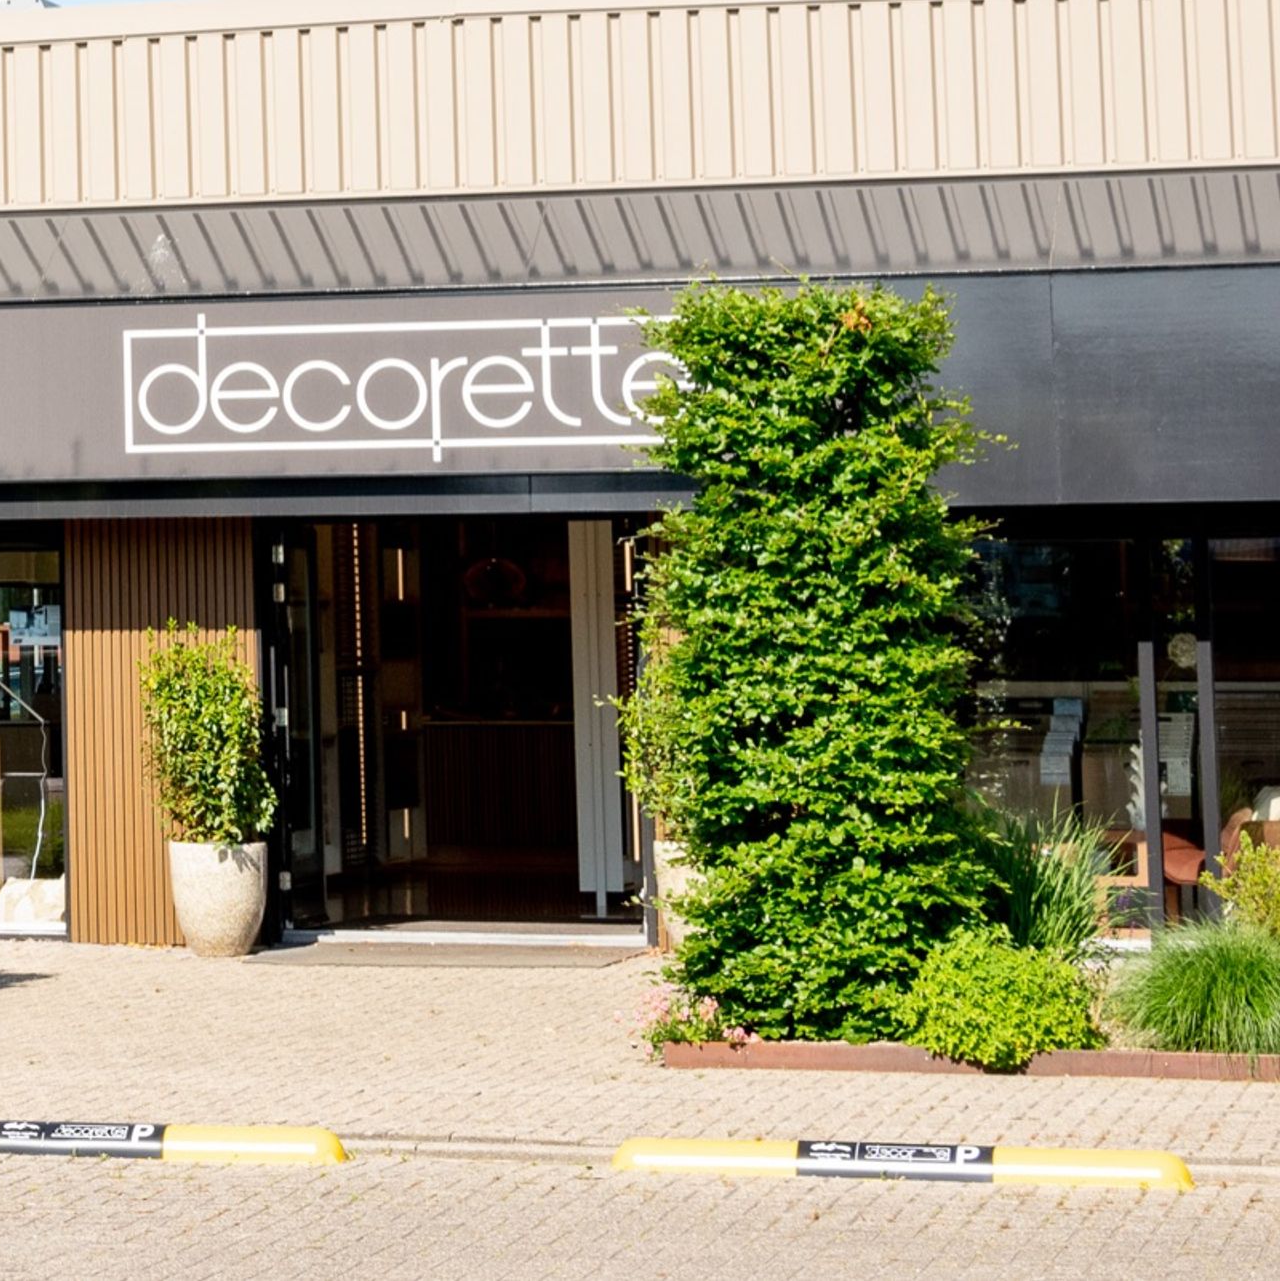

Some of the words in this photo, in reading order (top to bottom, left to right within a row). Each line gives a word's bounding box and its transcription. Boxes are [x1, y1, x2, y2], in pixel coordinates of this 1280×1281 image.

[137, 312, 698, 463] decorette
[132, 1124, 155, 1142] P
[957, 1145, 980, 1164] P
